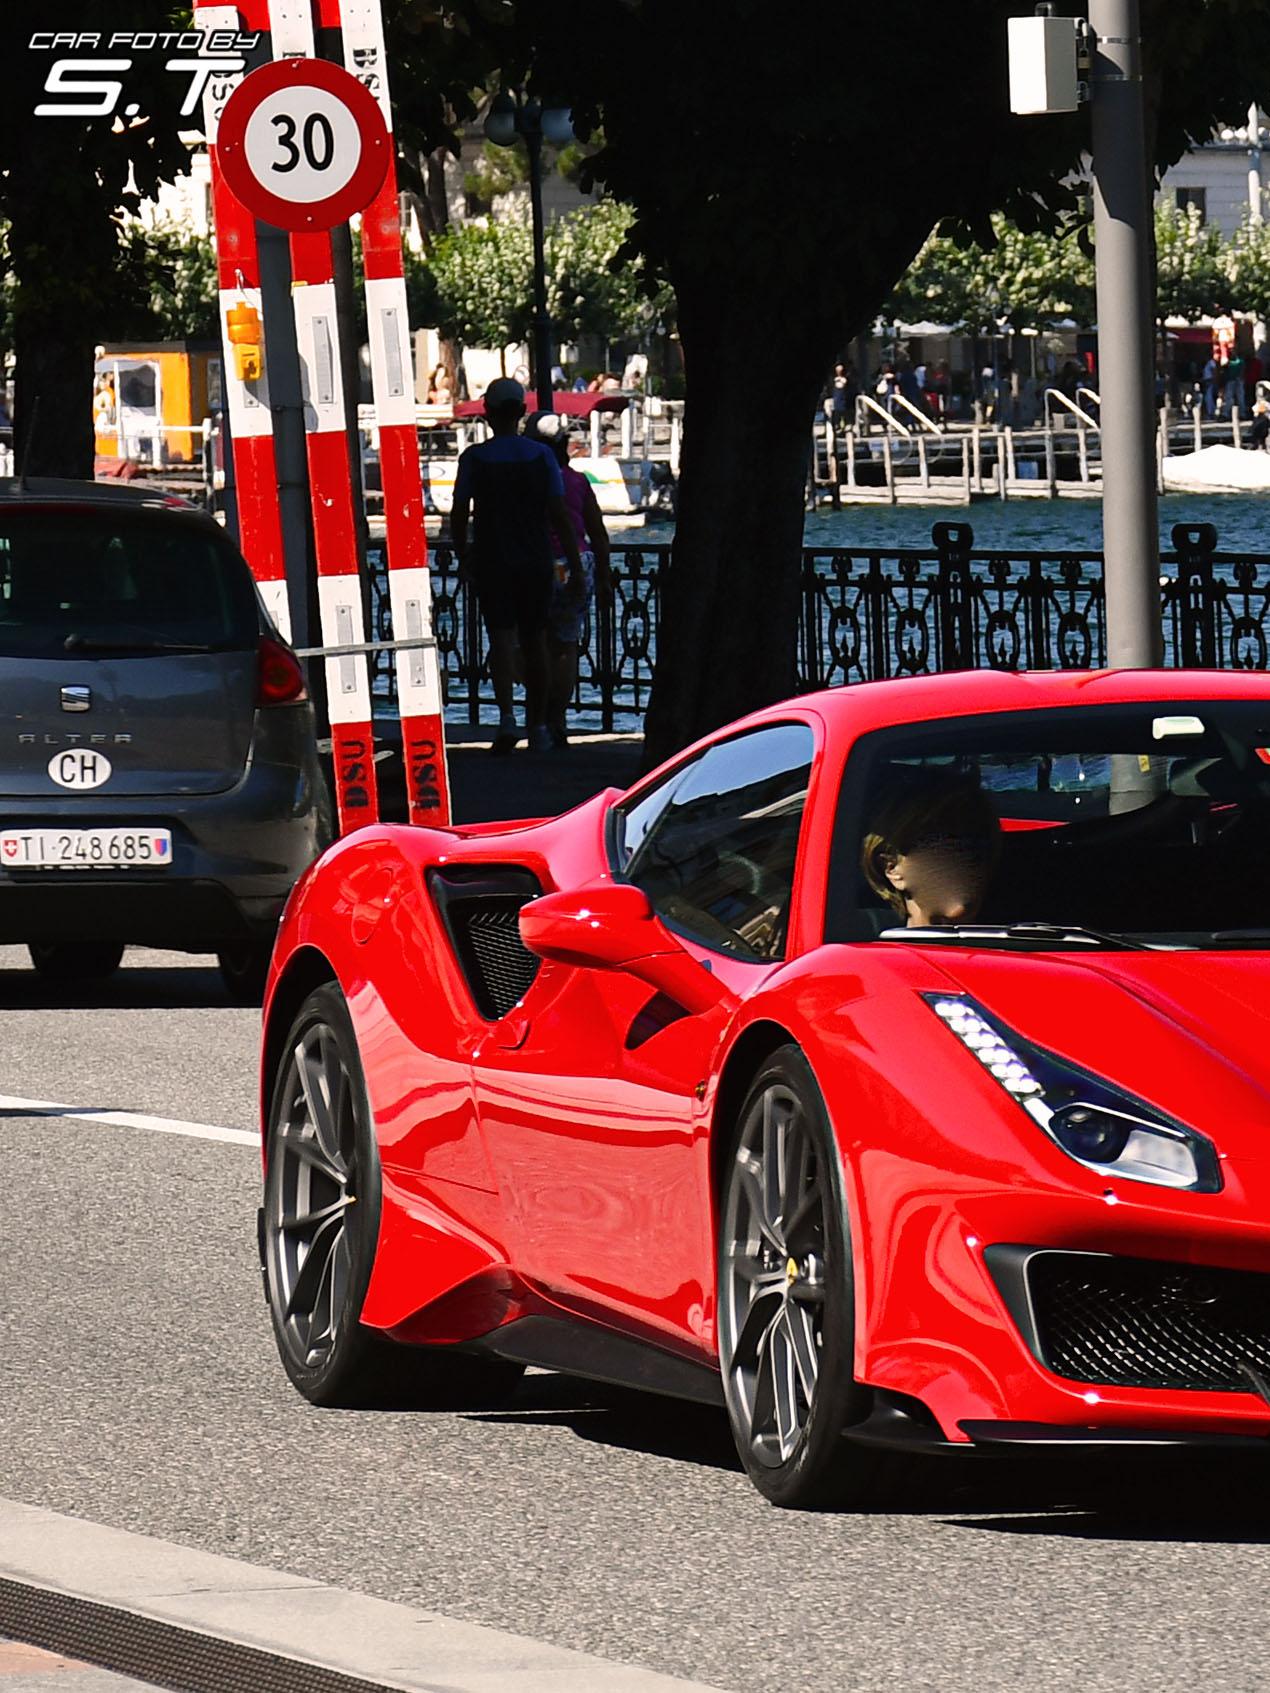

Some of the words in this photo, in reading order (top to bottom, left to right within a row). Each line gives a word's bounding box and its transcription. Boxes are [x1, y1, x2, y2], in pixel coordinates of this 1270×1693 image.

[270, 113, 335, 173] 30
[60, 754, 97, 783] CH
[341, 740, 369, 807] DSU
